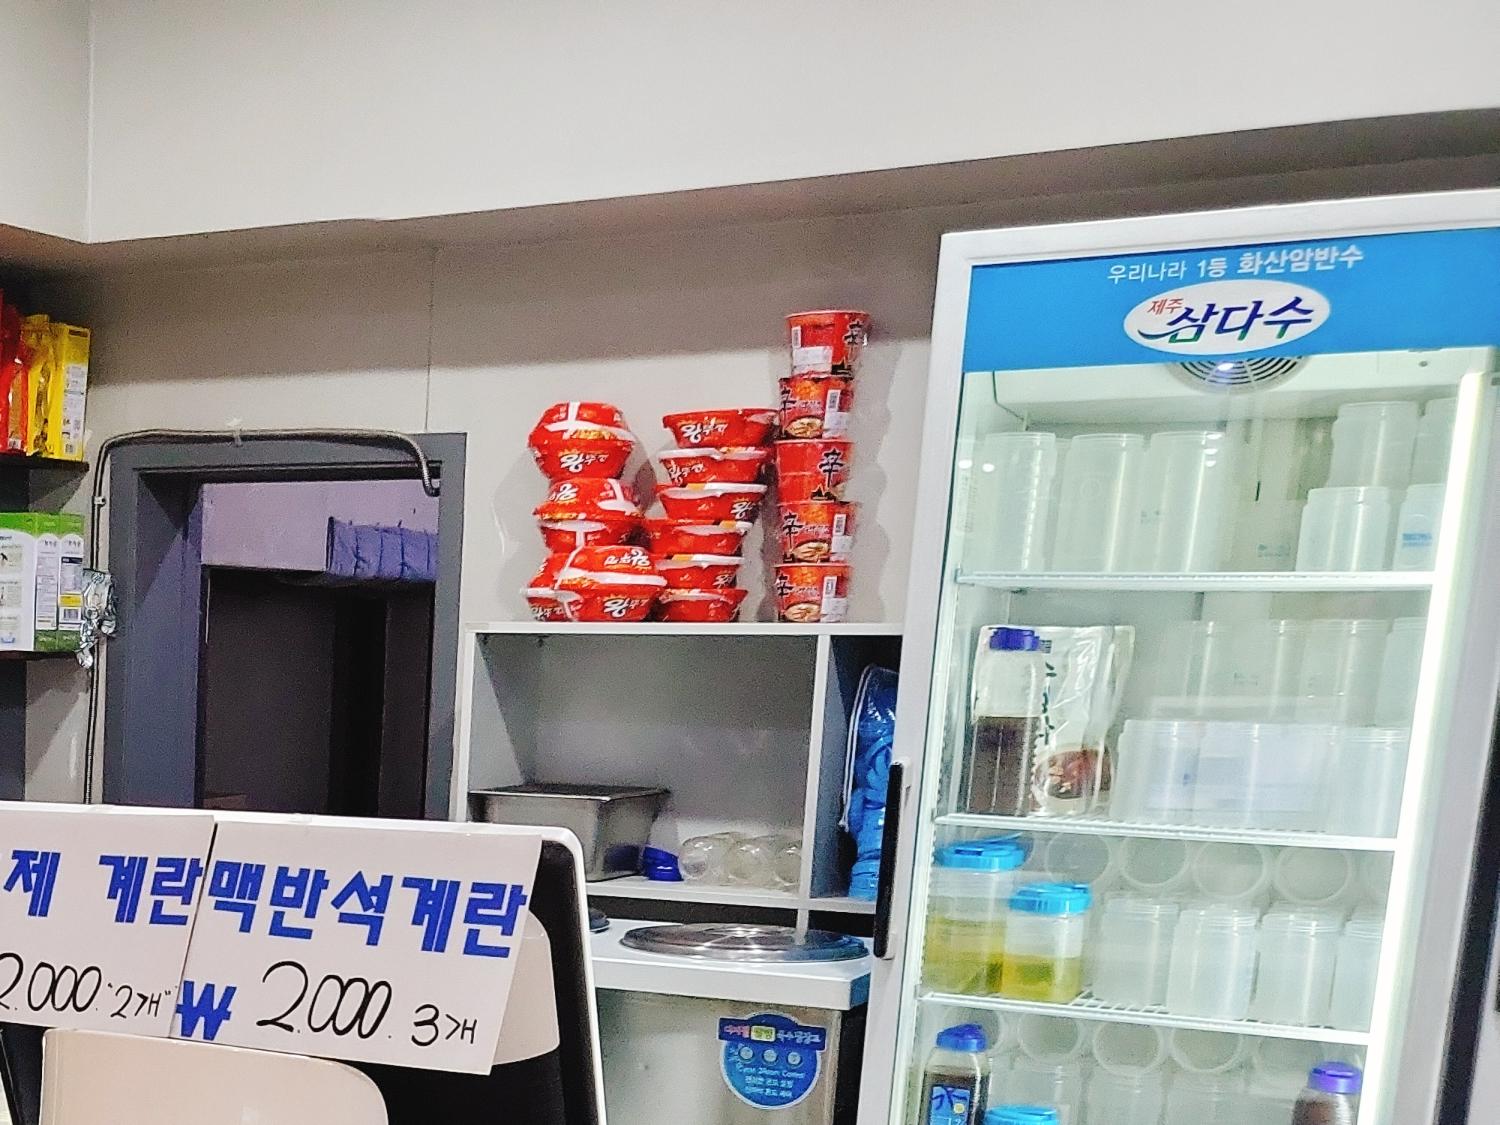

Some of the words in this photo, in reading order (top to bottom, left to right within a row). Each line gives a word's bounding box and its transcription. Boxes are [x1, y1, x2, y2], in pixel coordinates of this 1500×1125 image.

[1108, 260, 1187, 284] 우리나라
[1198, 257, 1228, 278] 1등
[1237, 245, 1364, 275] 화산암반수
[1147, 298, 1184, 315] 제주
[1164, 296, 1315, 344] 삼다수
[818, 448, 844, 487] 辛
[99, 855, 205, 926] 계란
[207, 859, 528, 959] 맥반석계란
